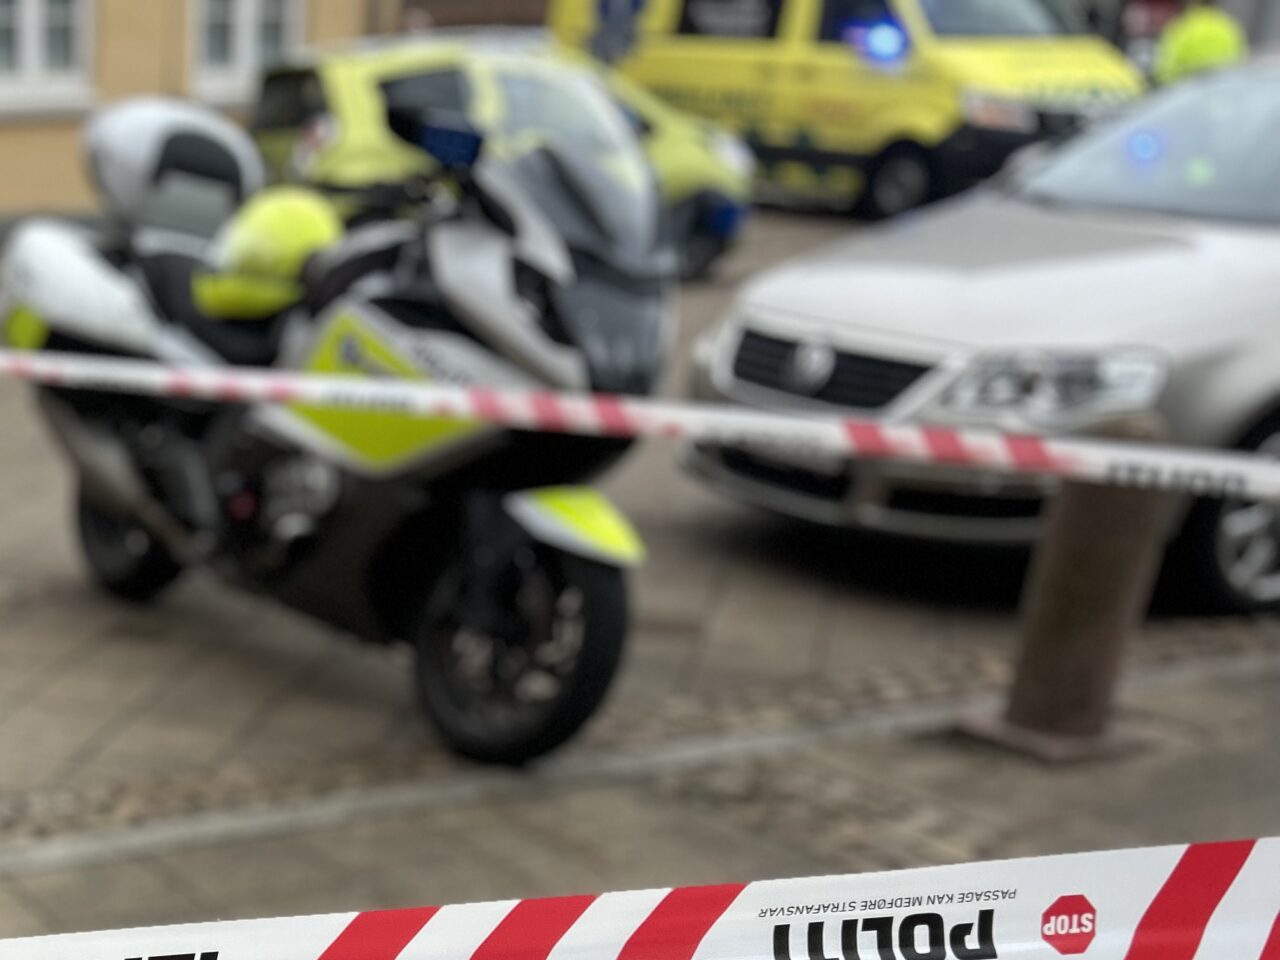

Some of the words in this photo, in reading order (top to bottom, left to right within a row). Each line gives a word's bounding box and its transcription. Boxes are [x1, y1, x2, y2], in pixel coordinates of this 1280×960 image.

[860, 895, 923, 912] MEDFØRE
[926, 893, 954, 906] KAN
[957, 888, 1018, 904] PASSAGE
[758, 900, 857, 918] STRAFANSVAR
[1043, 912, 1094, 936] STOP
